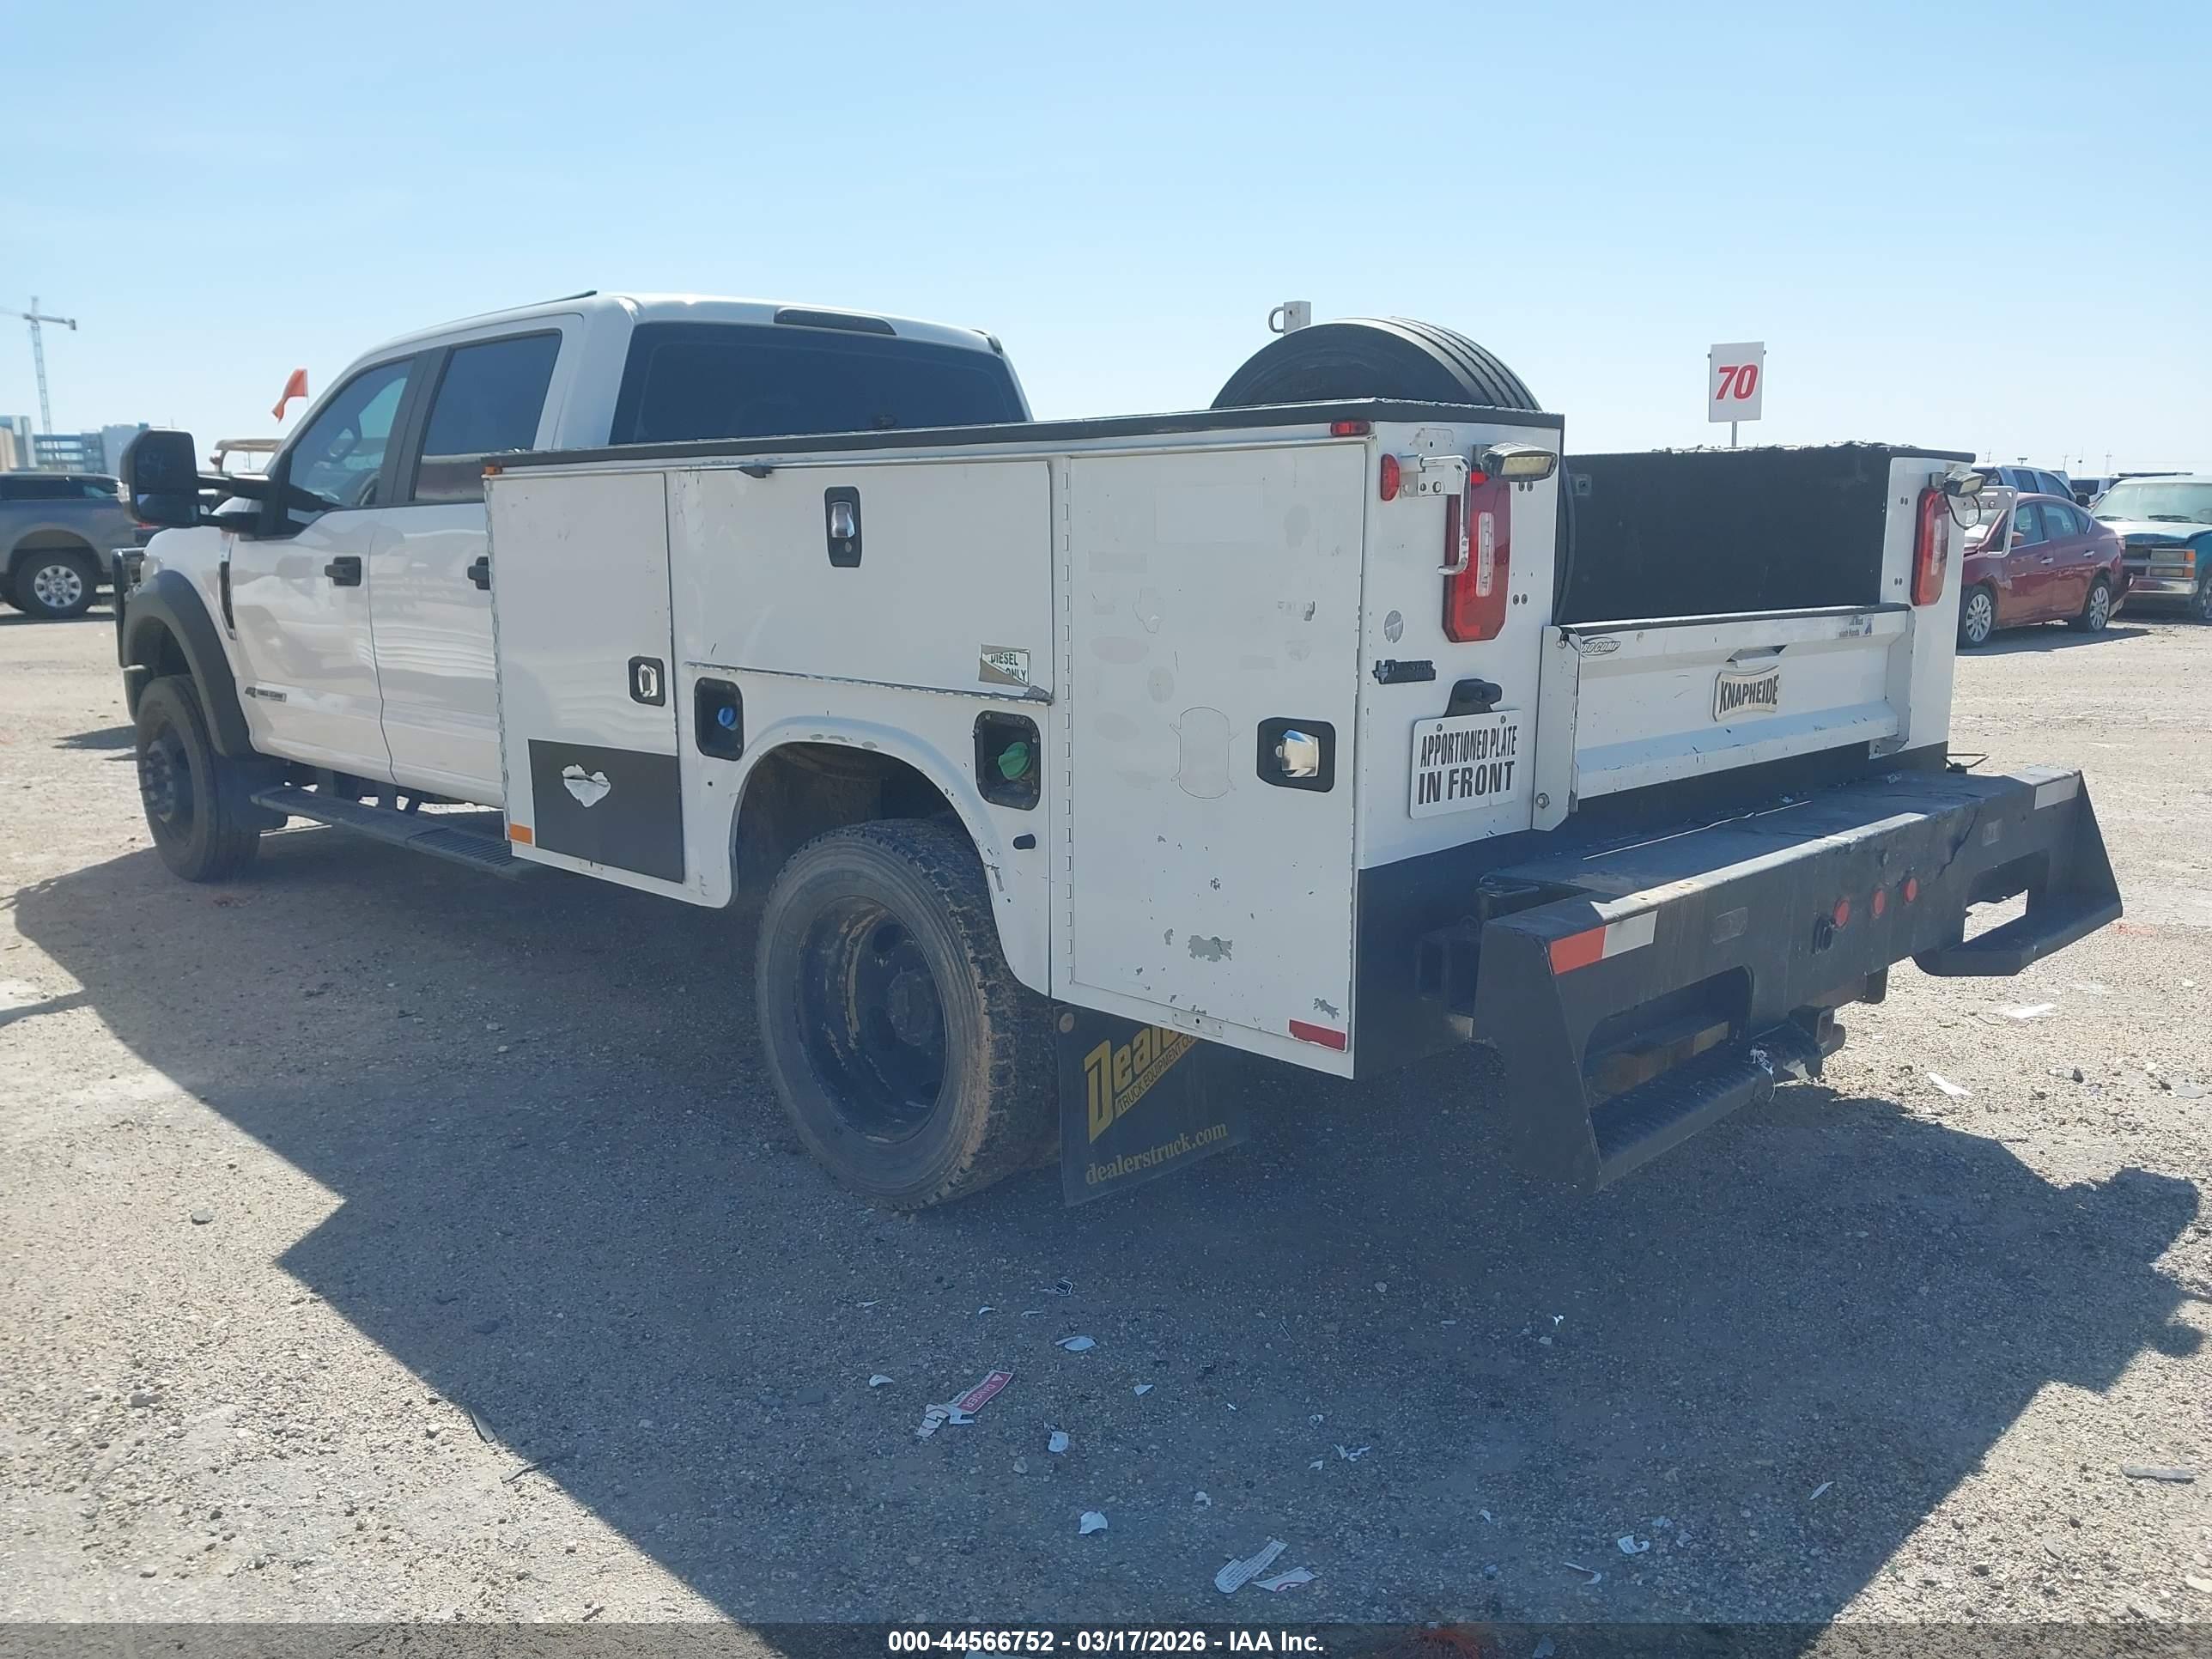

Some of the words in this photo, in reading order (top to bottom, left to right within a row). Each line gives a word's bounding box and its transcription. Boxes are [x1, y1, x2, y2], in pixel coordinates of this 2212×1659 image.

[1716, 364, 1759, 400] 70
[990, 653, 1018, 665] DIESEL
[1582, 641, 1595, 653] RO
[1719, 673, 1779, 714] KNAPHEIDE
[1420, 728, 1488, 768] APPORTIONED
[1489, 726, 1518, 758] PLATE
[1418, 770, 1442, 805] IN
[1447, 761, 1515, 800] FRONT
[1117, 1081, 1146, 1112] TRUCK
[1143, 1040, 1184, 1088] EQUIPMENT
[1085, 1123, 1228, 1185] dealerstruck.com
[962, 1383, 997, 1408] DANGER
